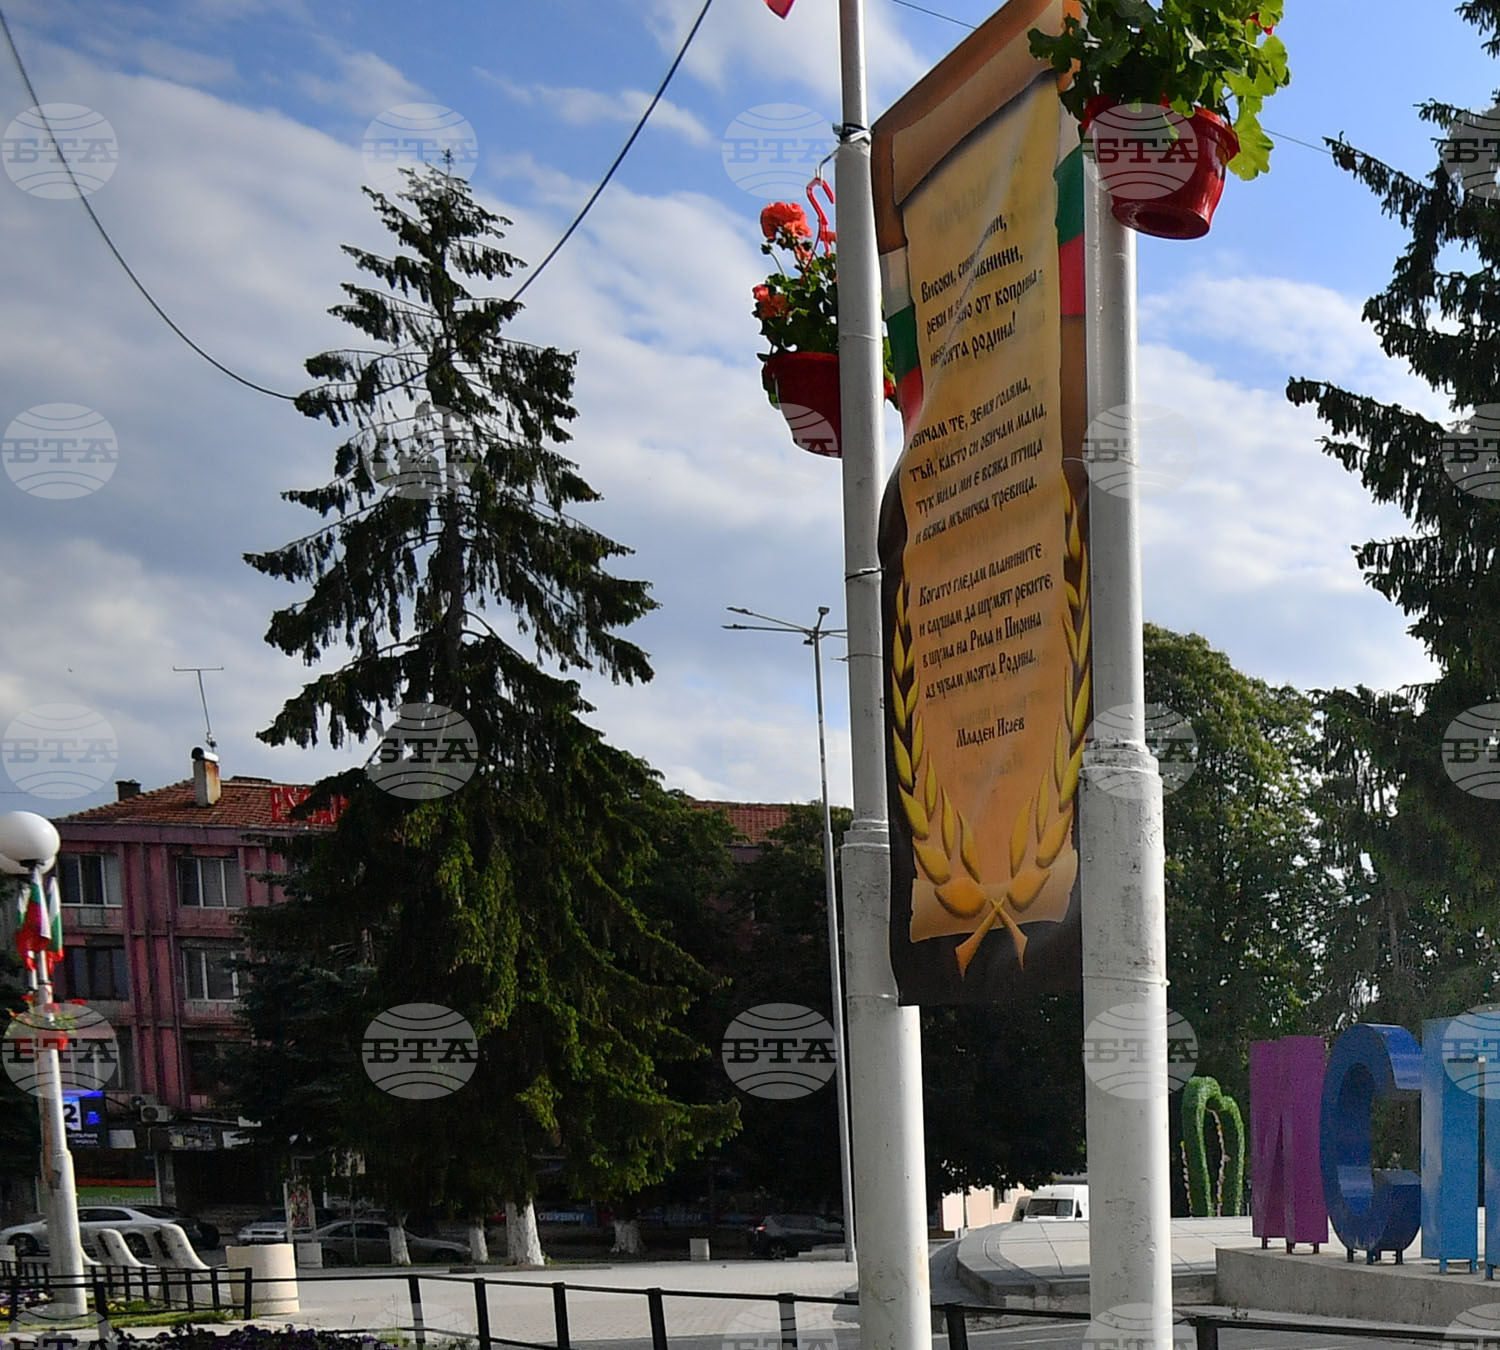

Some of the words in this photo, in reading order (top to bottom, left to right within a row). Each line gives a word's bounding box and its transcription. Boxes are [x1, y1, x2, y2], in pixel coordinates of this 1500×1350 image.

[920, 270, 957, 303] Високи,
[975, 294, 991, 314] от
[971, 310, 1016, 360] родина!
[949, 414, 969, 432] те,
[938, 446, 967, 472] както
[919, 584, 951, 608] Когато
[953, 566, 987, 593] гледам
